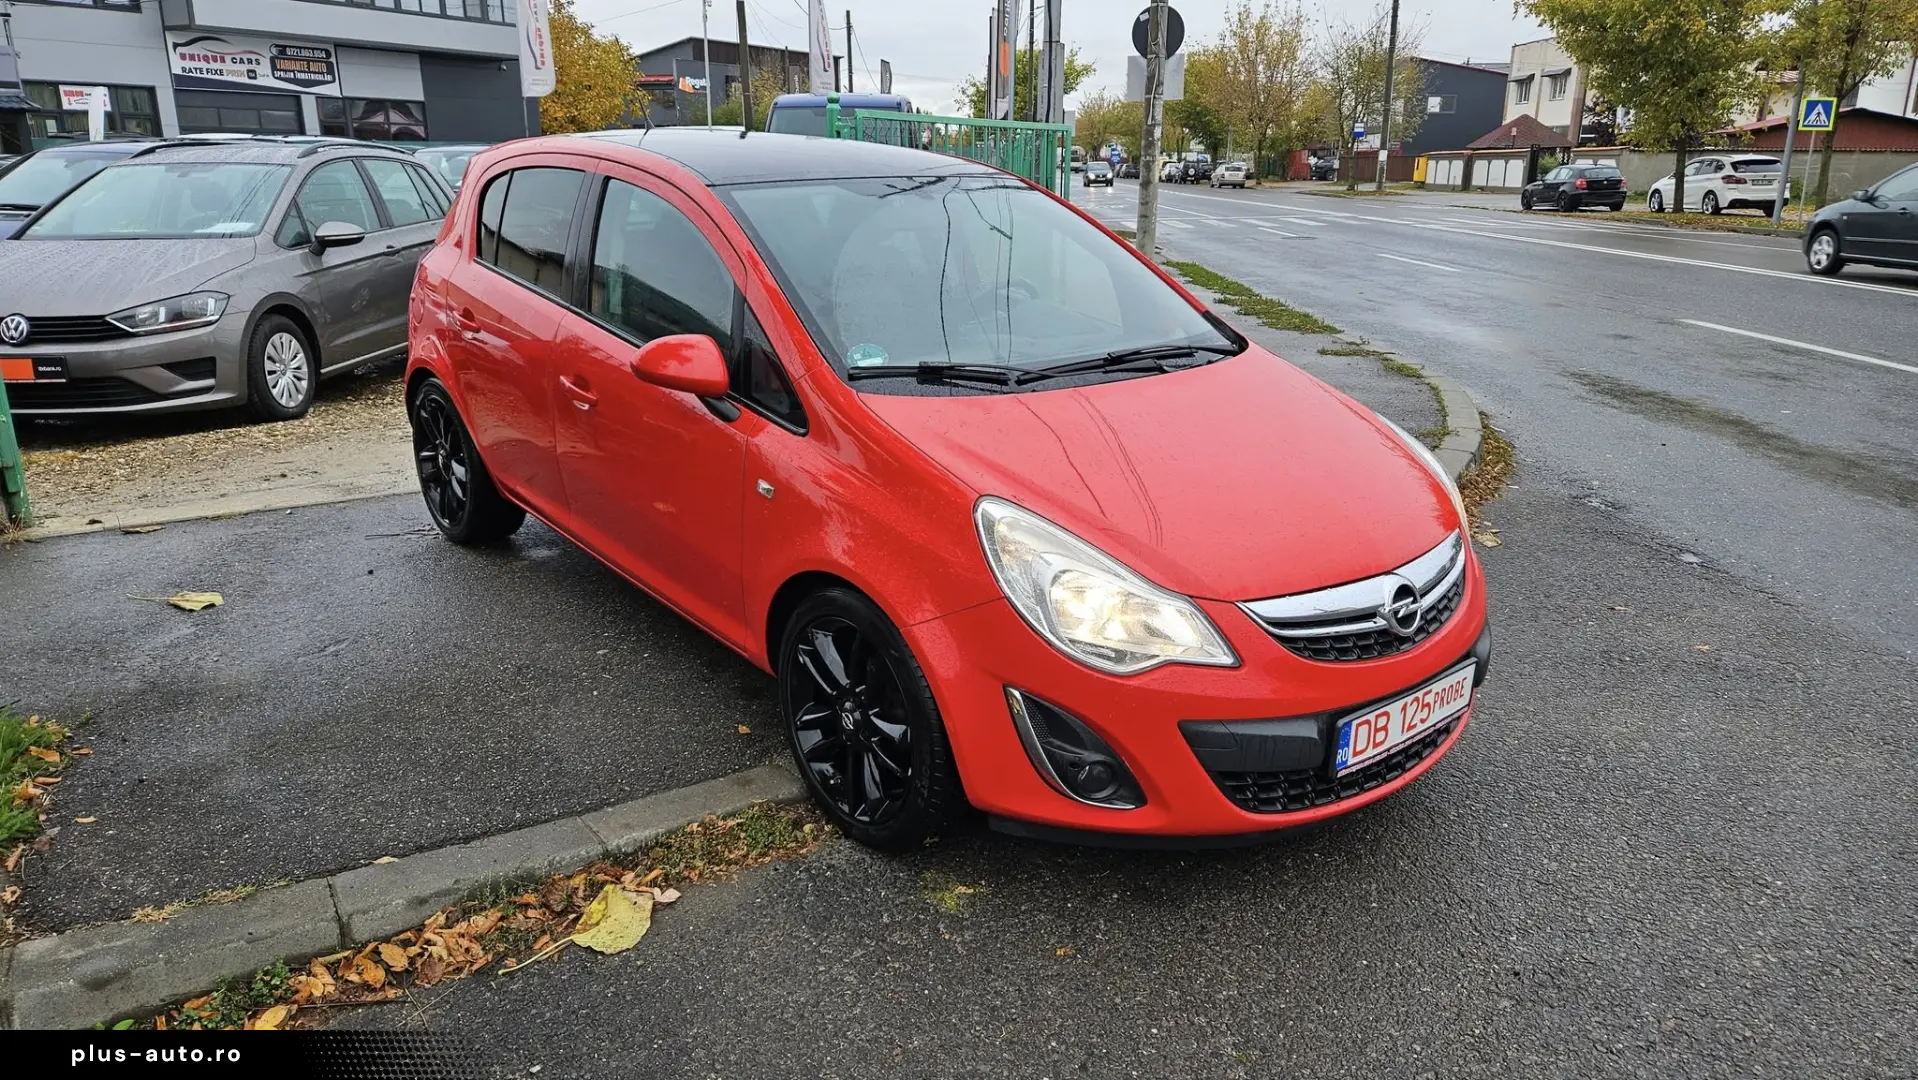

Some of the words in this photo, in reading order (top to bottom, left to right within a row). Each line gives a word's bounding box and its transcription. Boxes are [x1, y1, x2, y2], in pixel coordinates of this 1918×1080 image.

[178, 52, 226, 64] UNIQUE
[231, 56, 261, 66] CARS
[275, 59, 309, 71] VARIANTE
[309, 61, 327, 73] AUTO
[181, 66, 204, 75] RATE
[205, 67, 225, 77] FIXE
[1351, 710, 1391, 758] DB
[1400, 688, 1433, 736] 125
[1432, 676, 1468, 713] PROBE
[1336, 747, 1349, 765] RO
